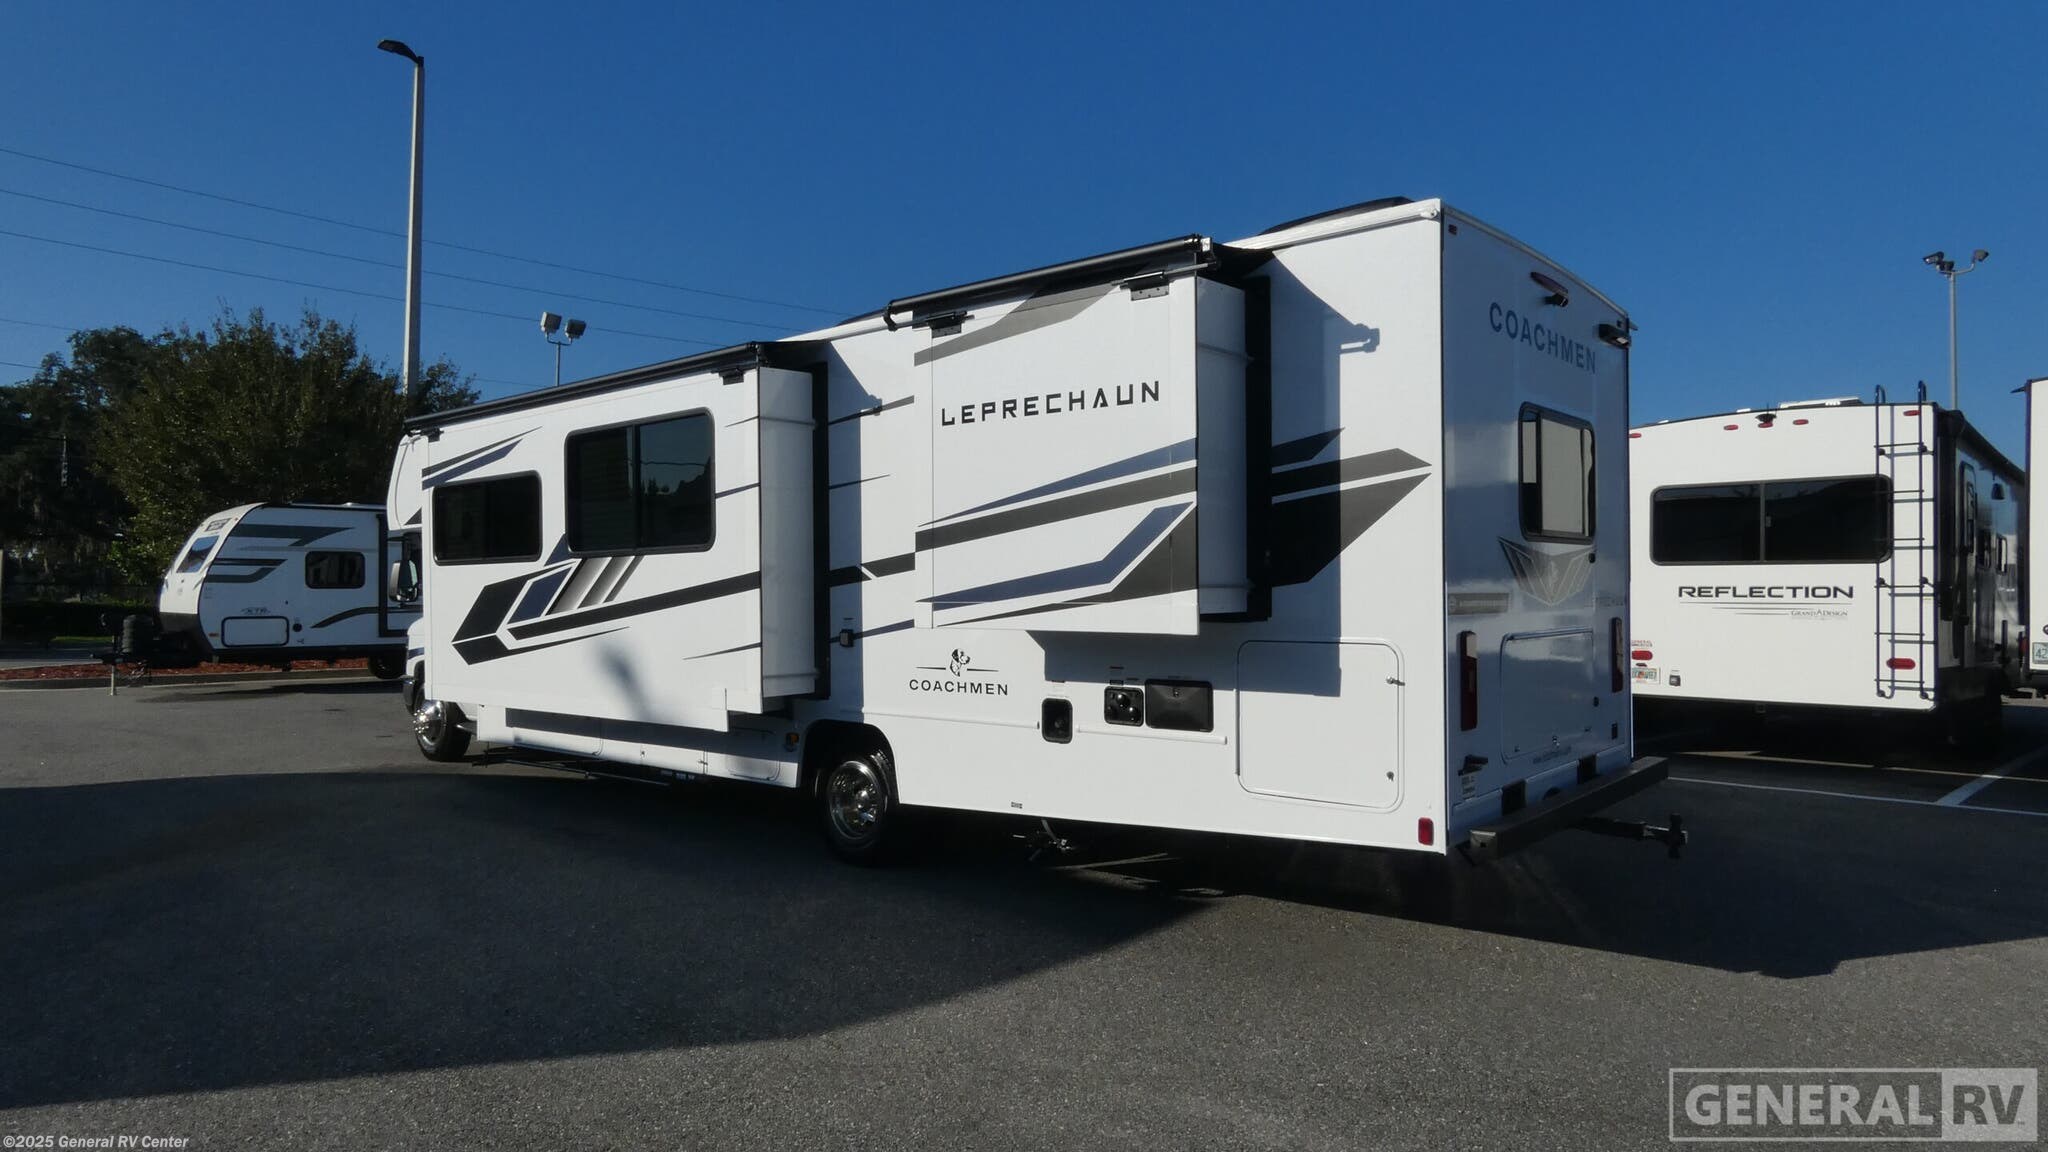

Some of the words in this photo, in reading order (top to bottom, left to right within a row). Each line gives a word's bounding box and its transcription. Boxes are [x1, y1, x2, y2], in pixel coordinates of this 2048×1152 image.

[1489, 301, 1596, 374] COACHMEN
[941, 380, 1159, 426] LEPRECHAUN
[1678, 586, 1854, 599] REFLECTION
[1822, 610, 1849, 618] DESIGN
[909, 679, 1008, 695] COACHMEN
